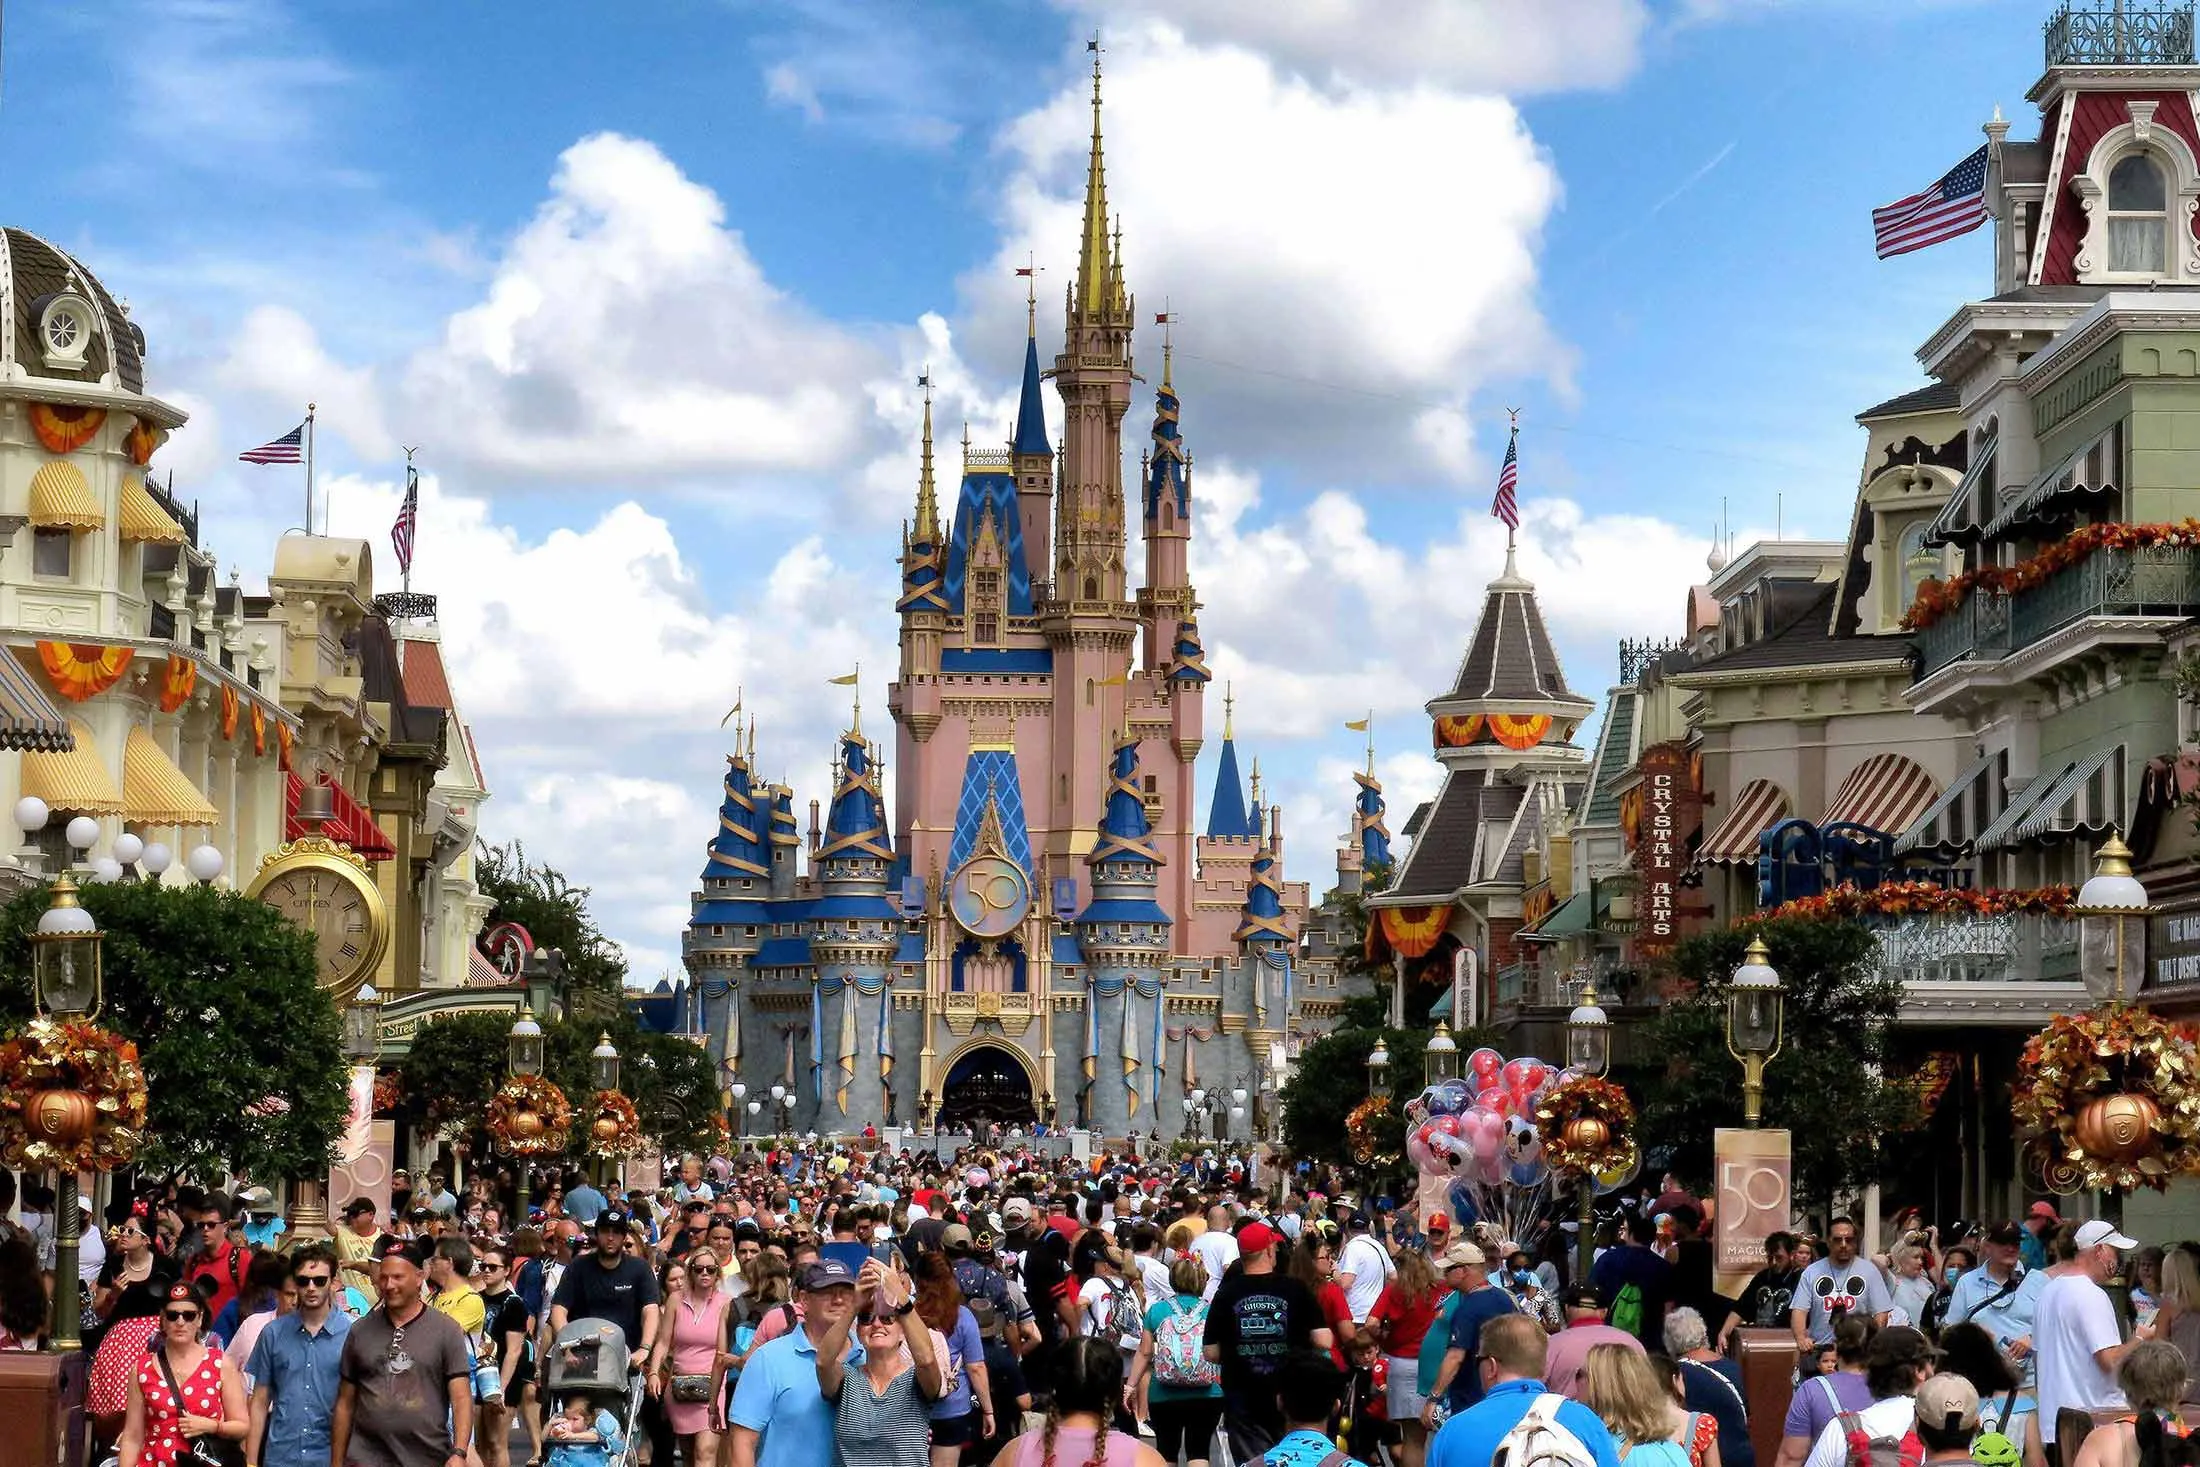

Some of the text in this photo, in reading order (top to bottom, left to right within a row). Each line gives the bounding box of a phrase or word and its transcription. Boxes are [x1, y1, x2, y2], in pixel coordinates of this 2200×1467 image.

[1652, 774, 1673, 935] CRYSTAL ARTS
[291, 899, 331, 909] CITIZEN
[967, 870, 1020, 927] 50
[1723, 1162, 1785, 1231] 50
[1243, 1302, 1278, 1311] GHOSTS
[1823, 1295, 1857, 1312] DAD
